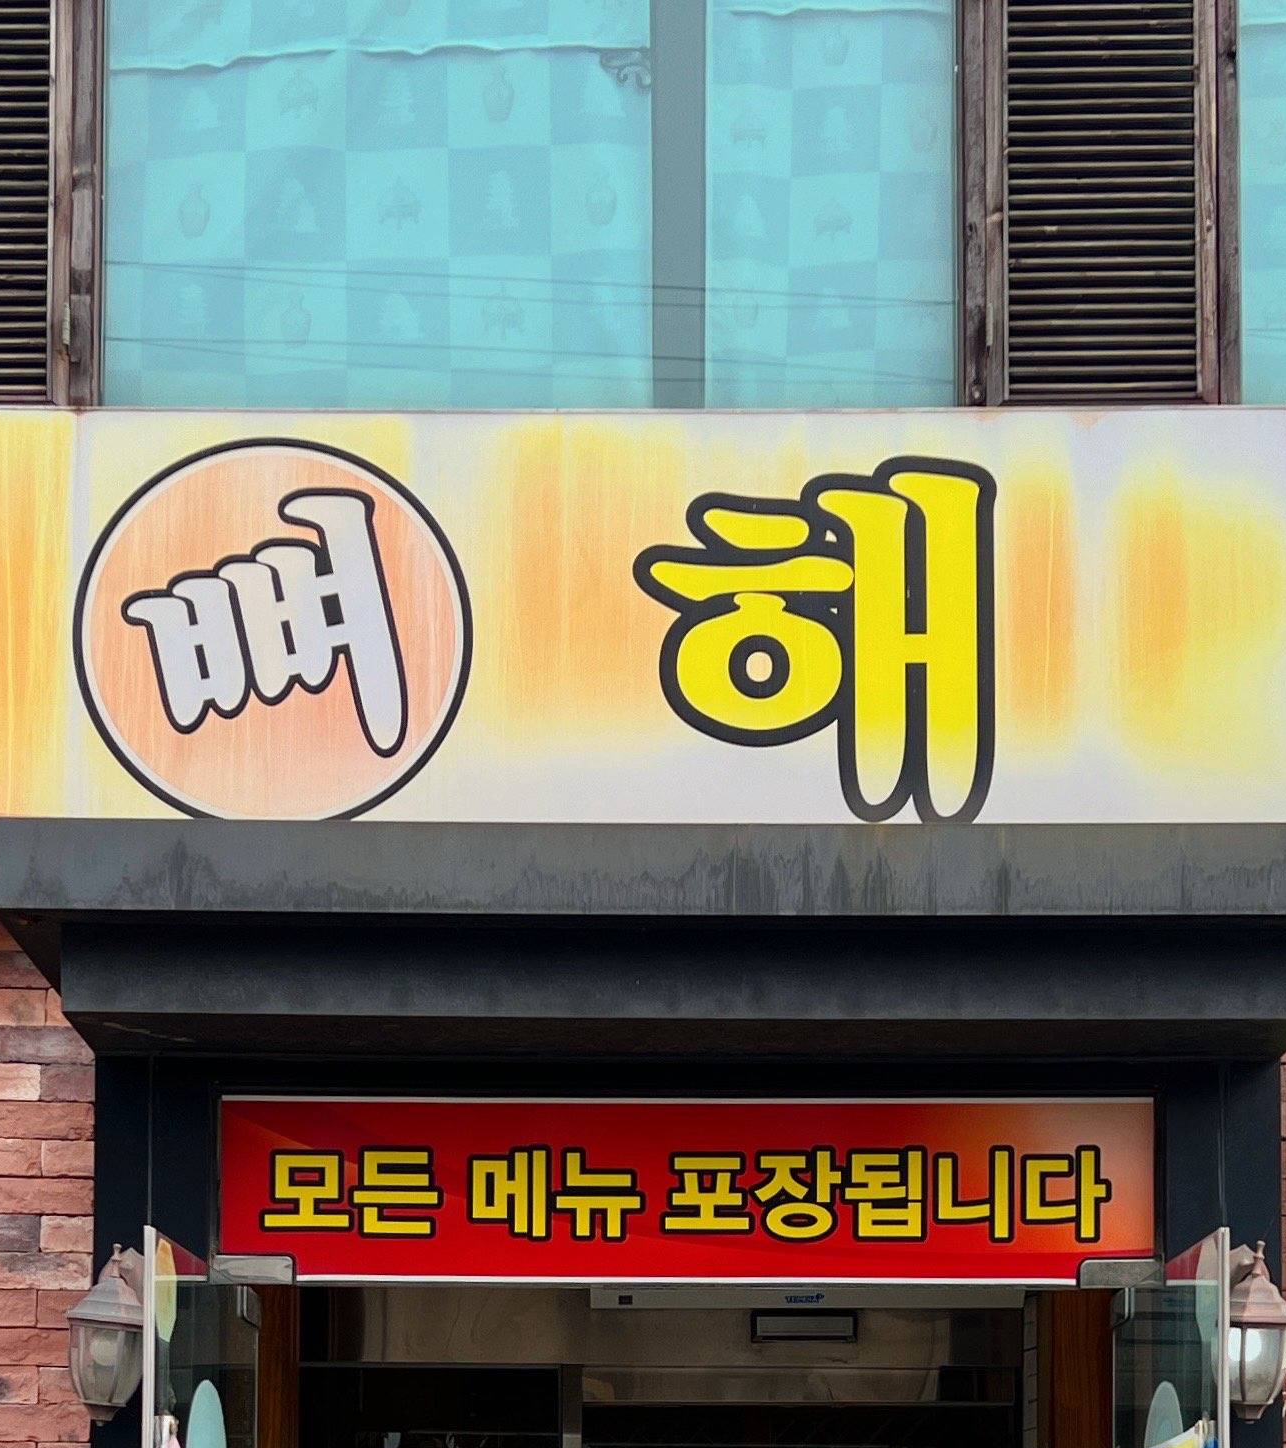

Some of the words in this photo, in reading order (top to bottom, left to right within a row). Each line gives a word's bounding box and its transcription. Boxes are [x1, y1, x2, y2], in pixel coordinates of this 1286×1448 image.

[259, 1144, 444, 1239] 모든
[466, 1143, 645, 1242] 메뉴
[659, 1143, 1112, 1242] 포장됩니다
